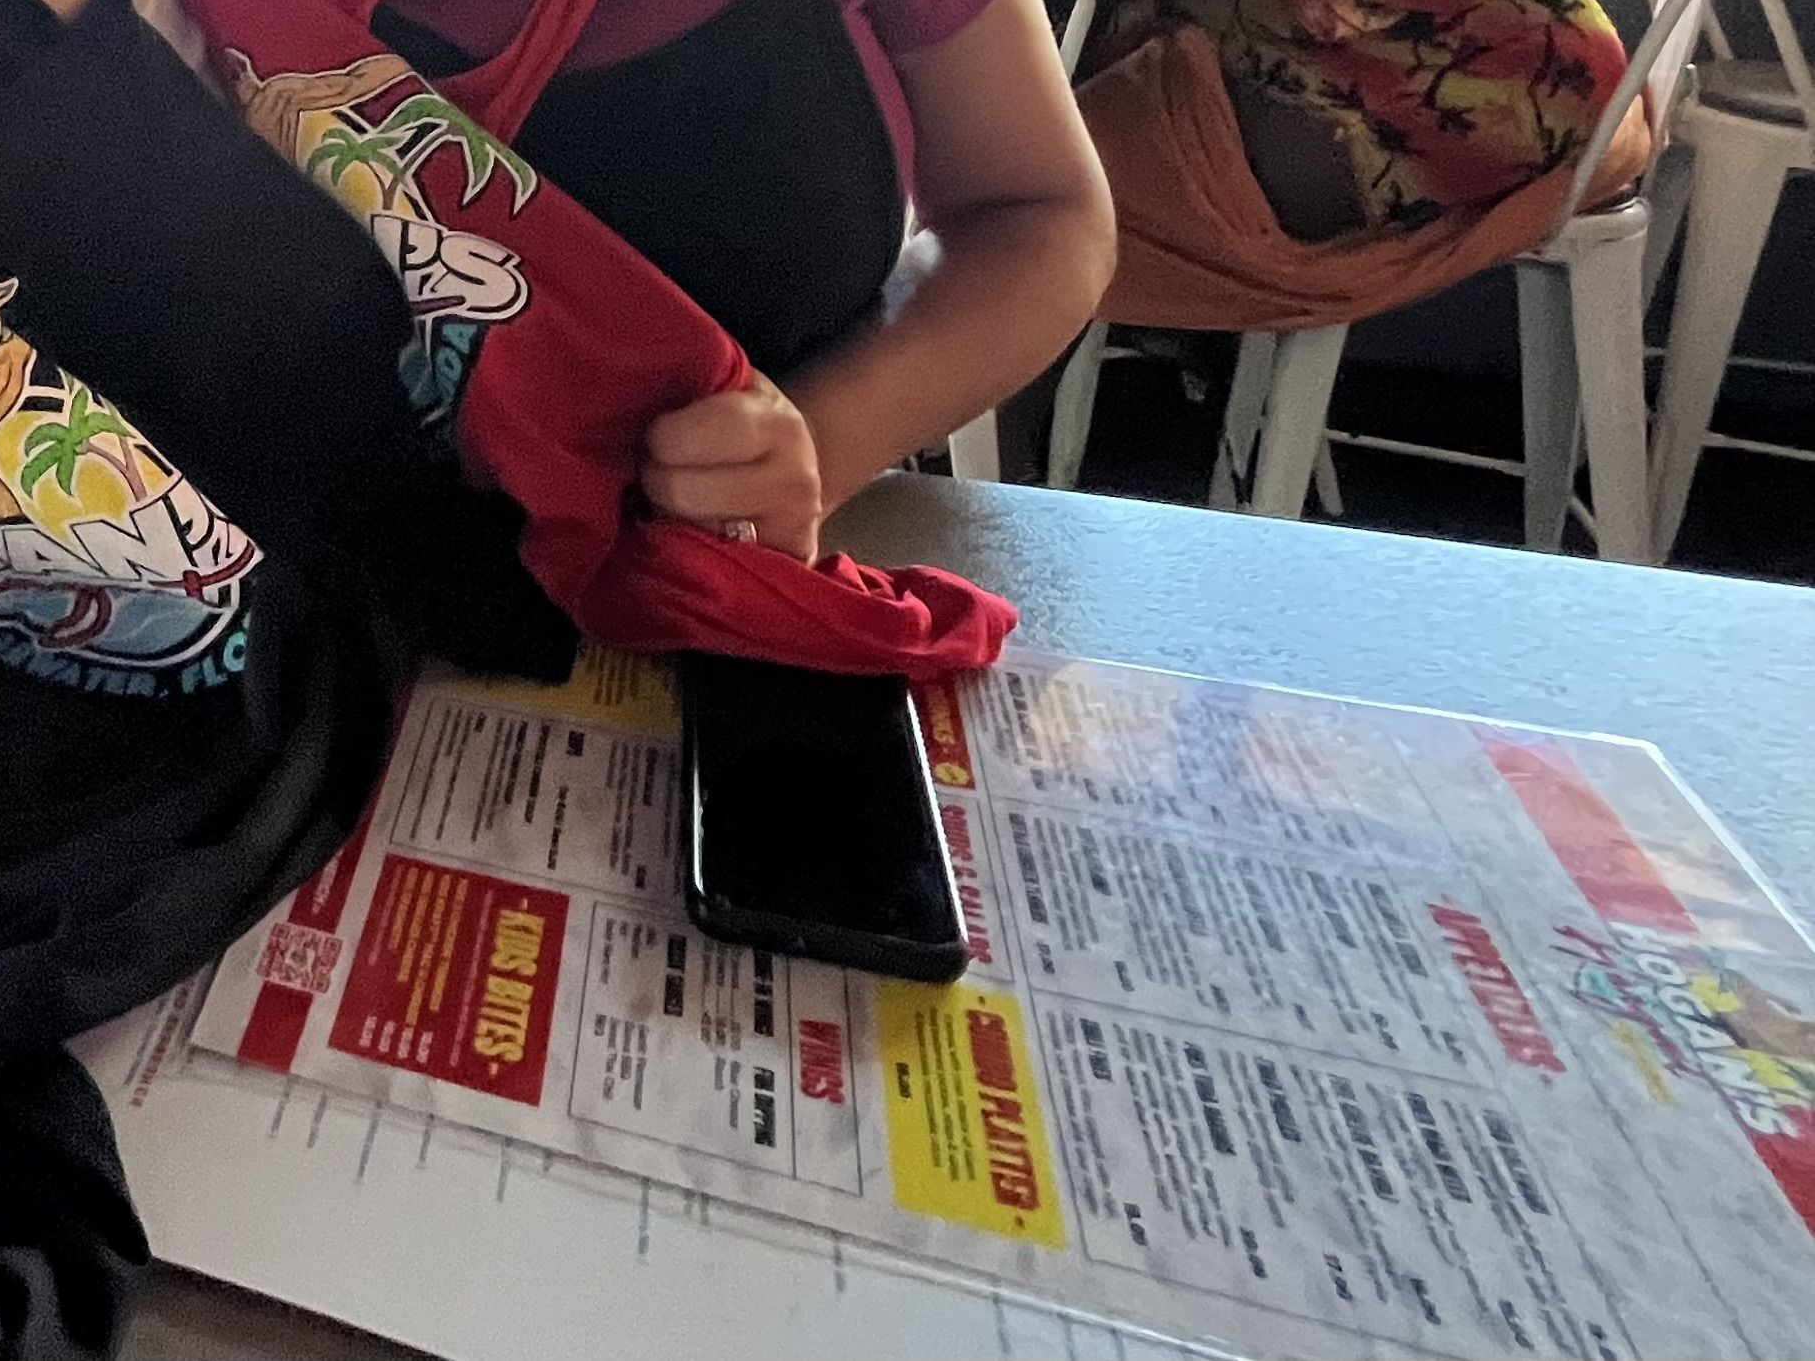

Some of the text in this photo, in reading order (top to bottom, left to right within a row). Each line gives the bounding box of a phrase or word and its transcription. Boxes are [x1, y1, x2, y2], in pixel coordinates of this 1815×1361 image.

[475, 909, 544, 1061] KIDS BITES
[800, 1019, 845, 1105] WINGS
